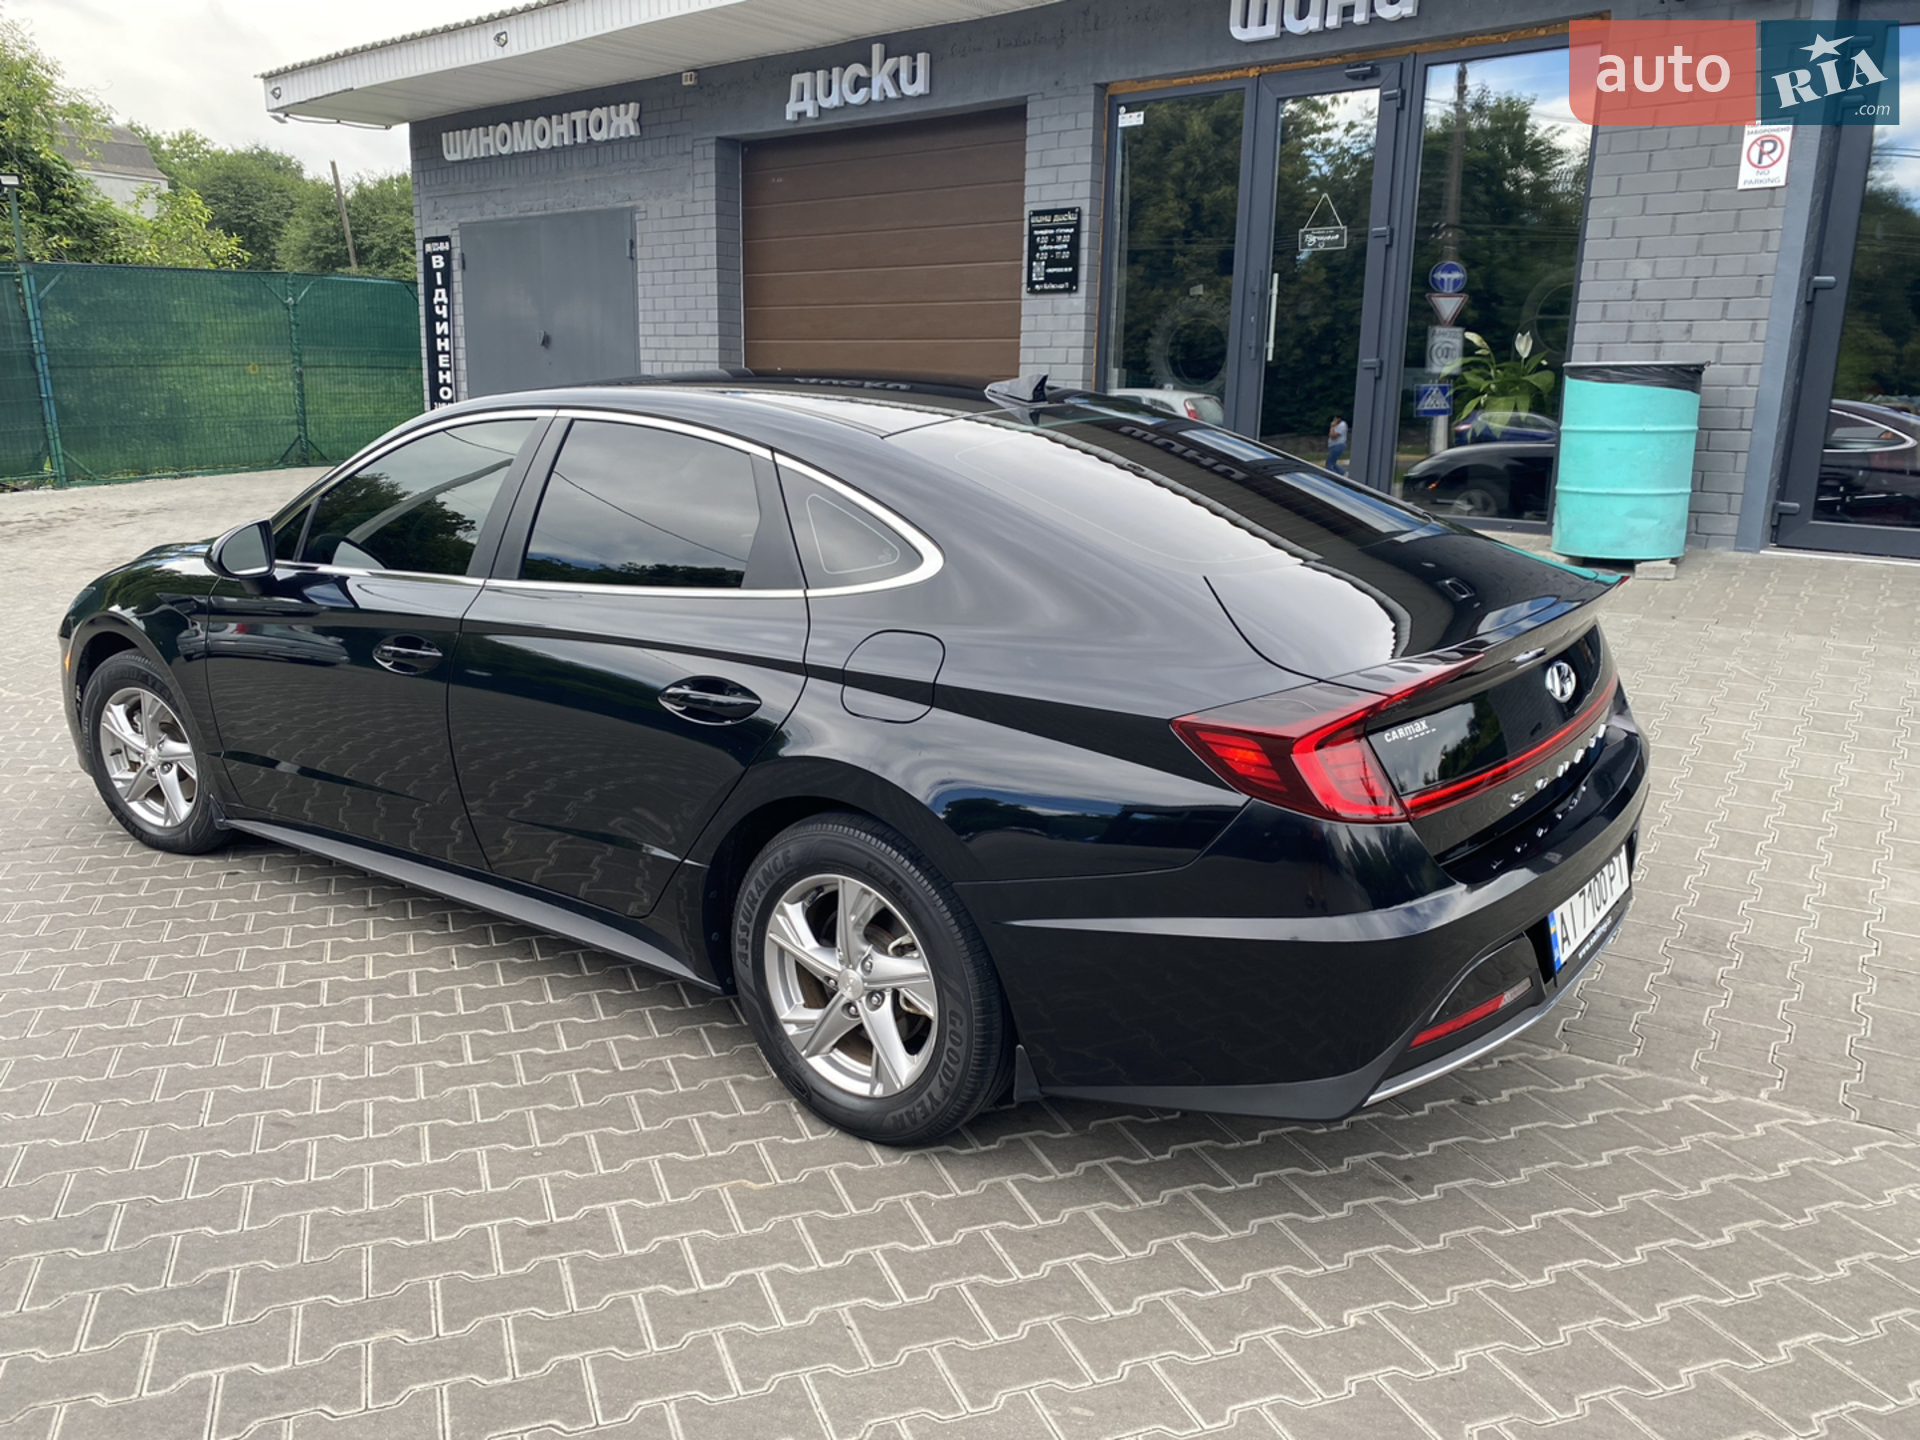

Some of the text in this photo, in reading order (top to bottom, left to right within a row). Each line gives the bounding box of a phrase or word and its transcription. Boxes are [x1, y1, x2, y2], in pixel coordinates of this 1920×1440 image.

[786, 43, 930, 121] диски
[441, 102, 641, 162] шиномонтаж
[1743, 176, 1781, 186] PARKING
[431, 255, 453, 400] ВІДЧИНЕНО
[736, 849, 794, 969] ASSURANCE
[1579, 870, 1608, 930] 7100
